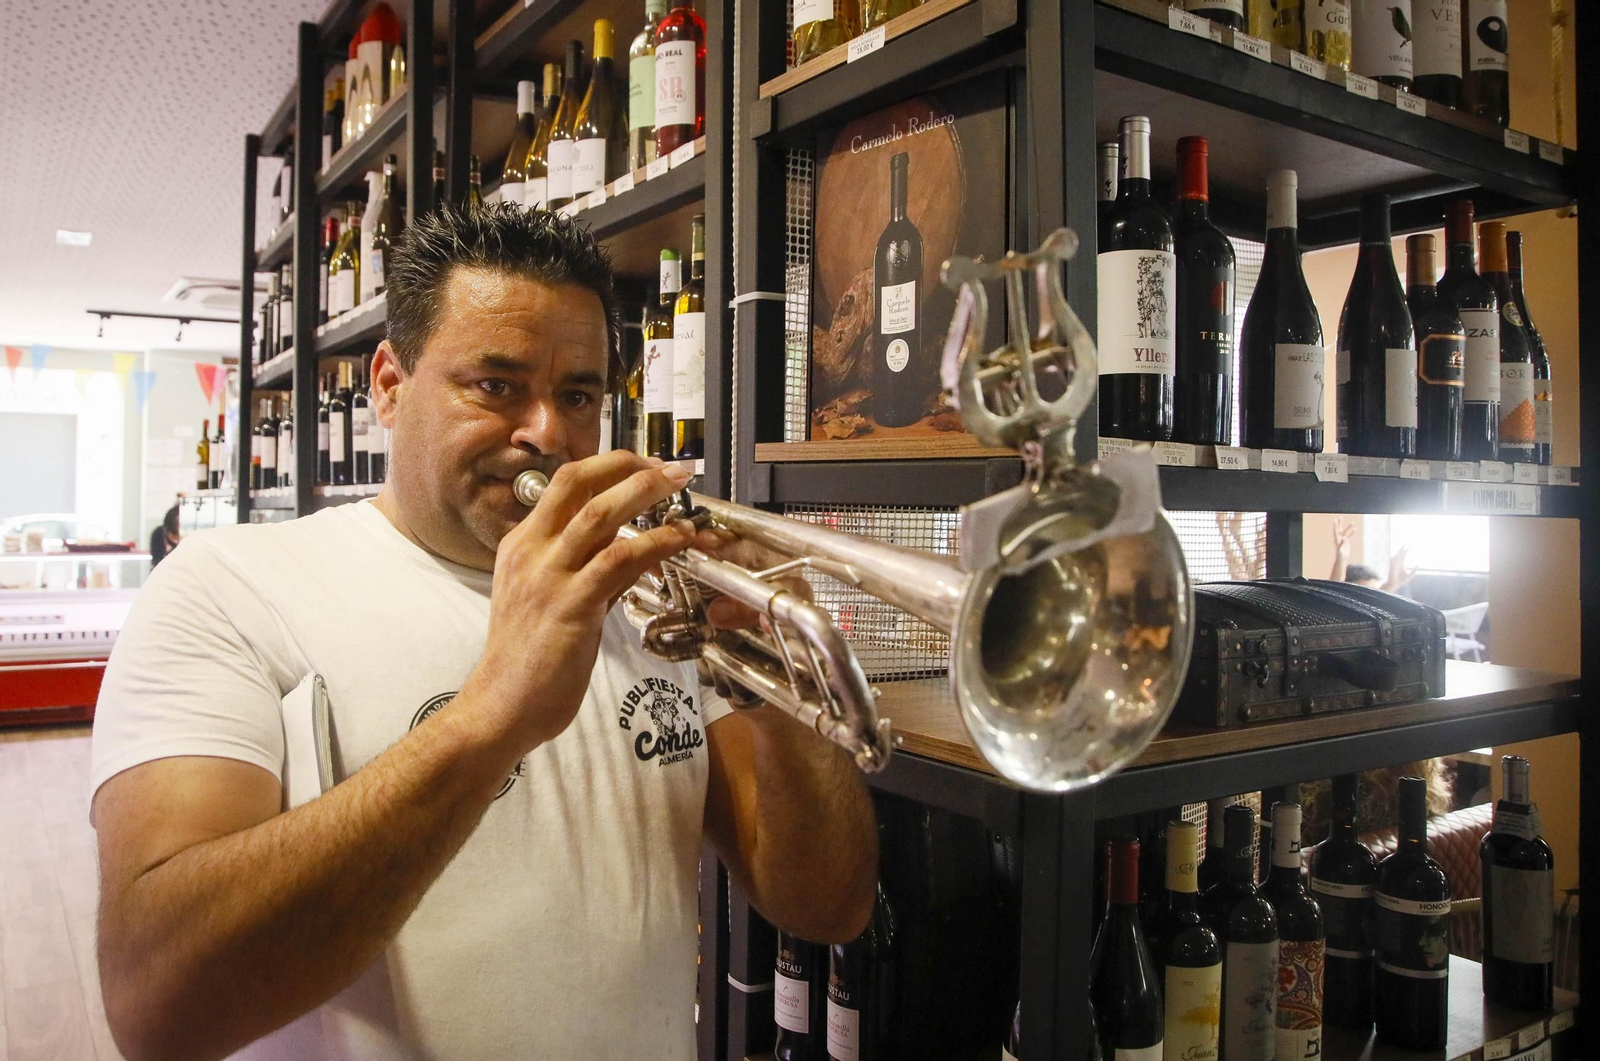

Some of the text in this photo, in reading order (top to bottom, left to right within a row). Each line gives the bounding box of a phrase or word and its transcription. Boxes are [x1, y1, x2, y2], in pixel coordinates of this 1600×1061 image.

[665, 48, 683, 58] REAL
[850, 111, 955, 154] Carmelo Rodero
[634, 721, 703, 761] Conde
